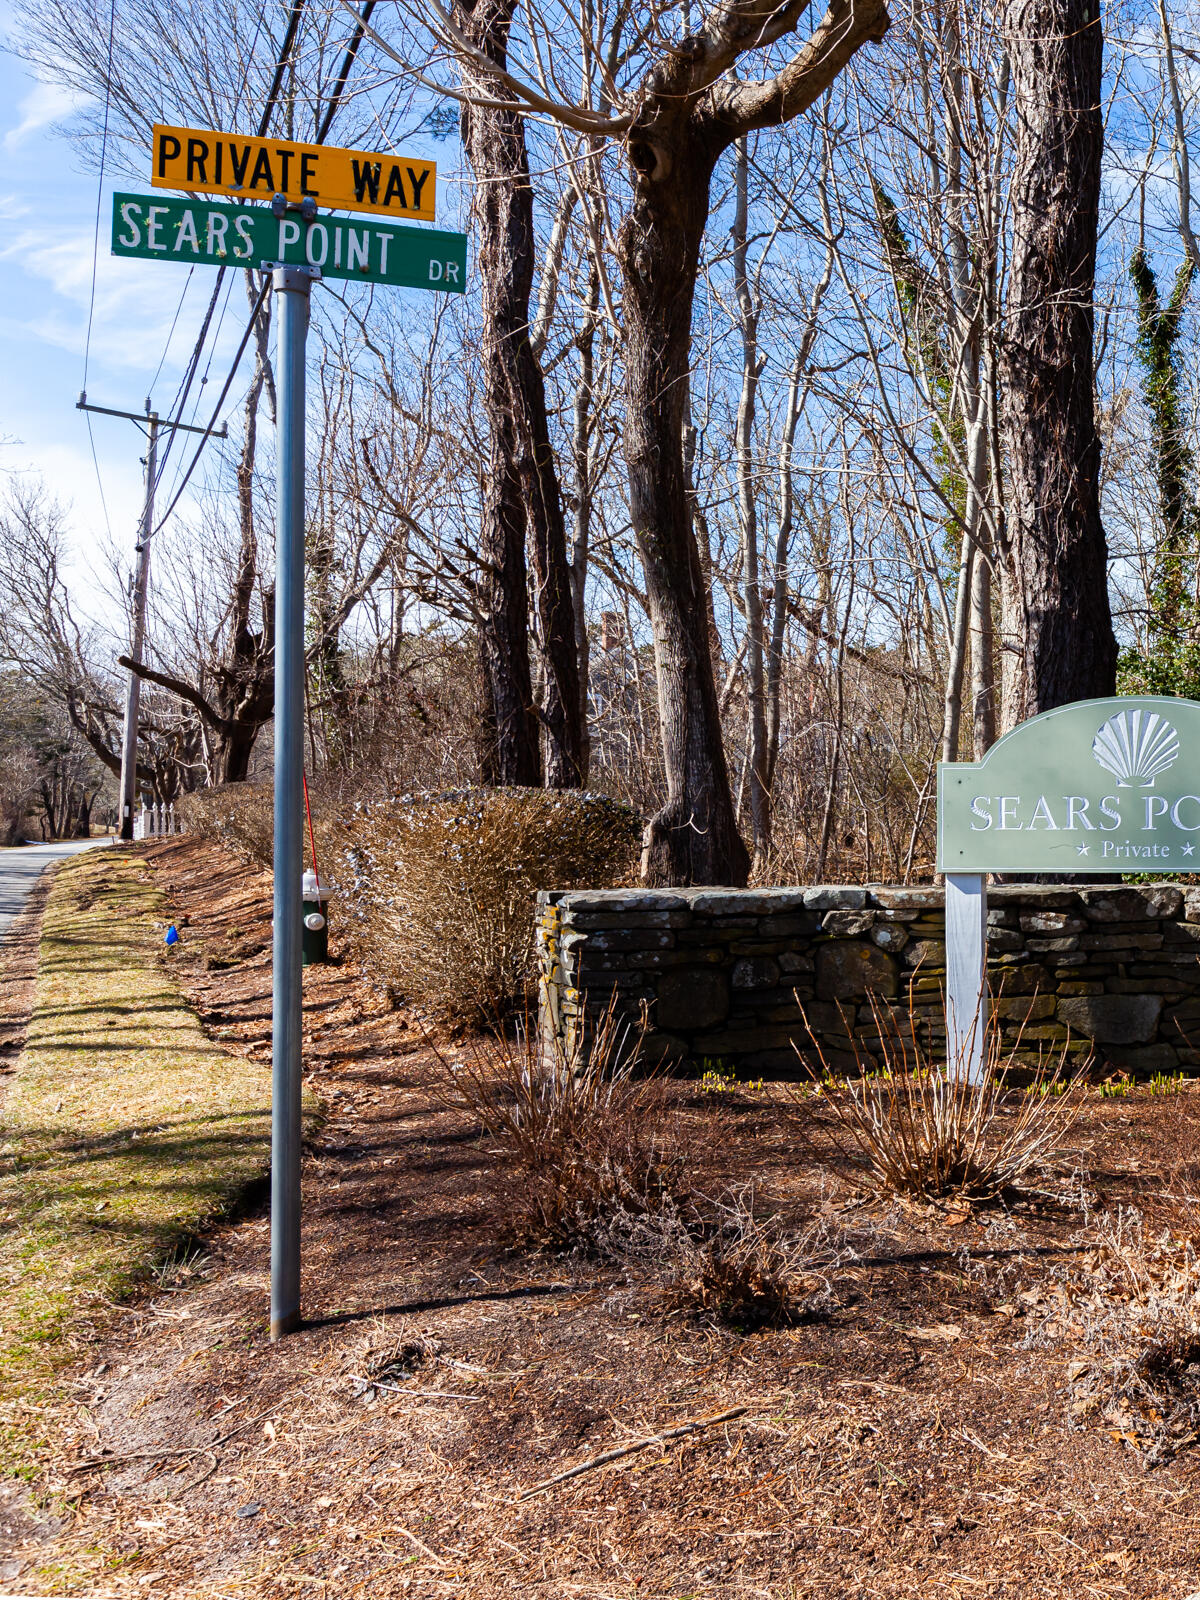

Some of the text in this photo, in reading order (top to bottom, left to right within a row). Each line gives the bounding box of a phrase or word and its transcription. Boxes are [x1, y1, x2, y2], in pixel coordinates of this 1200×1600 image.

[158, 135, 430, 210] PRIVATE WAY
[118, 202, 459, 283] SEARS POINT DR
[970, 795, 1122, 831] SEARS
[1101, 840, 1170, 858] Private
